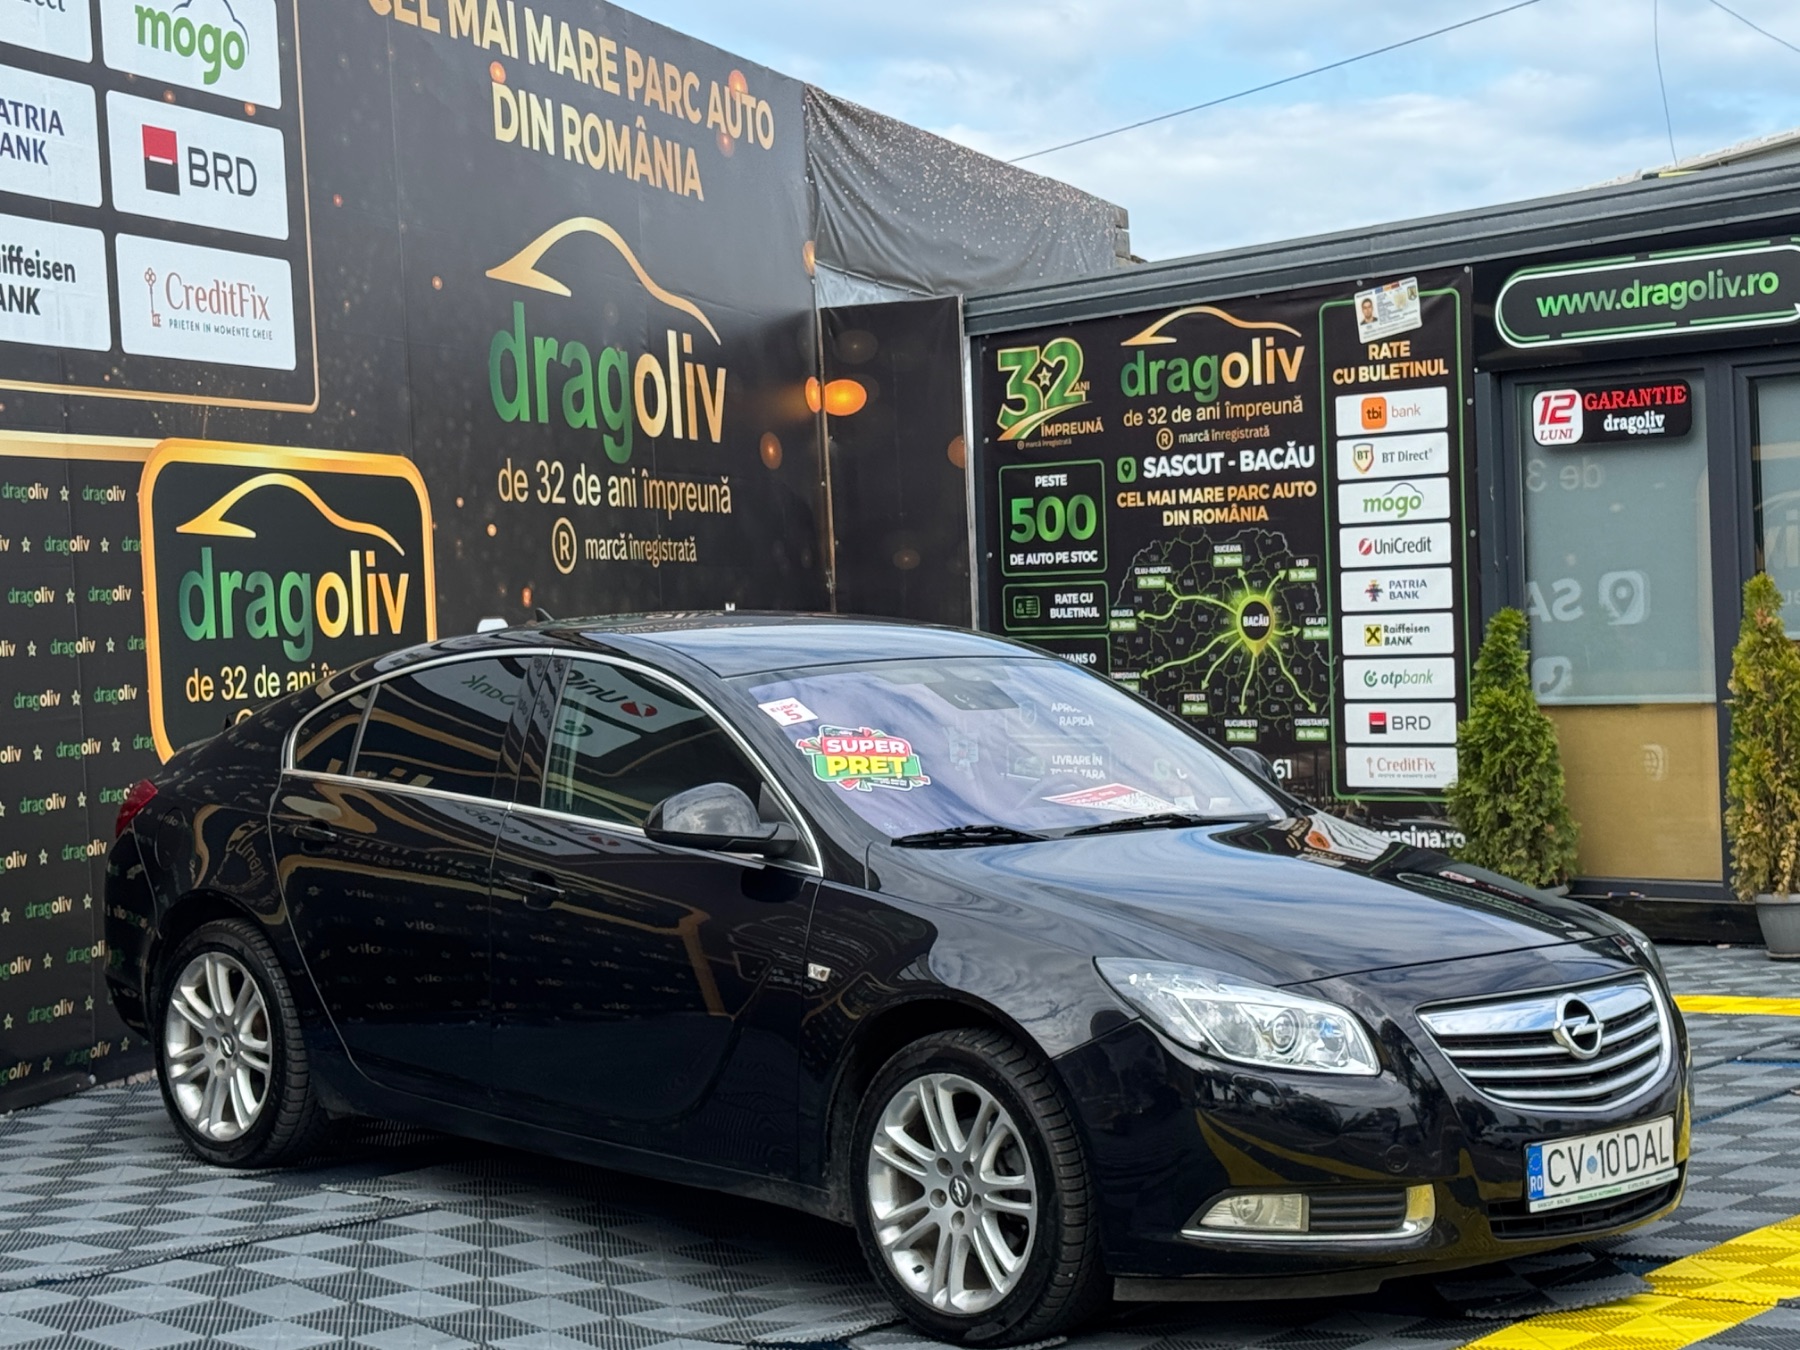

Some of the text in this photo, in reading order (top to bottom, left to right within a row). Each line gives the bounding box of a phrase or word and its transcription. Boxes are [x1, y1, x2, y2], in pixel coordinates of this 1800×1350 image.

[135, 4, 246, 85] mogo
[449, 0, 518, 59] MAI
[524, 7, 620, 95] MARE
[625, 46, 701, 124] PARC
[707, 80, 775, 150] AUTO
[491, 82, 704, 201] DIN ROMÂNIA
[187, 146, 258, 197] BRD
[165, 271, 271, 322] CreditFix
[1536, 268, 1780, 318] www.dragoliv.ro
[168, 318, 273, 341] PRIETEN IN MOMENTE CHEIE
[1368, 340, 1411, 361] RATE
[1120, 336, 1305, 402] dragoliv
[1332, 358, 1449, 385] CU BULETINUL
[489, 301, 727, 464] dragoliv
[997, 337, 1091, 430] 32 ANI
[1584, 384, 1687, 412] GARANTIE
[1123, 395, 1303, 427] de 32 de ani împreună
[1366, 403, 1421, 420] tbi bank
[1539, 394, 1576, 426] 12
[1041, 416, 1105, 437] ÎMPREUNĂ
[1603, 410, 1665, 435] dragoliv
[1178, 429, 1210, 444] marcă
[1211, 425, 1270, 444] înregistrată
[1540, 428, 1574, 441] LUNI
[1143, 451, 1225, 479] SASCUT
[1239, 441, 1316, 473] BACĂU
[1356, 450, 1370, 461] BT
[1382, 451, 1396, 464] BT
[498, 457, 732, 520] de 32 de ani împreună
[1035, 474, 1068, 488] PESTE
[2, 482, 126, 505] dragoliv dragoliv
[1116, 480, 1317, 508] CEL MAI MARE PARC AUTO
[1163, 505, 1269, 527] DIN ROMÂNIA
[1362, 495, 1422, 518] mogo
[1010, 494, 1097, 543] 500
[44, 534, 90, 556] dragoliv
[585, 532, 628, 561] marcă
[629, 532, 698, 568] înregistrată
[1374, 536, 1432, 555] UniCredit
[1010, 550, 1098, 566] DE AUTO PE STOC
[8, 584, 132, 607] dragoliv dragoliv
[1388, 579, 1428, 590] PATRIA
[1388, 589, 1419, 600] BANK
[179, 546, 409, 662] dragoliv
[1055, 592, 1094, 605] RATE CU
[1050, 606, 1100, 619] BULETINUL
[1242, 614, 1270, 628] BACĂU
[1383, 623, 1430, 635] Raiffeisen
[50, 636, 96, 658] dragoliv
[1384, 636, 1413, 647] BANK
[186, 667, 214, 703] de
[220, 665, 248, 701] 32
[254, 664, 280, 699] de
[1380, 669, 1433, 687] otpbank
[13, 684, 137, 711] dragoliv dragoliv
[769, 703, 799, 713] EURO
[784, 709, 802, 721] 5
[1391, 715, 1432, 731] BRD
[56, 738, 102, 760] dragoliv
[826, 738, 905, 754] SUPER
[1377, 757, 1436, 772] CreditFix
[20, 793, 66, 815] dragoliv
[62, 839, 107, 862] dragoliv
[25, 896, 72, 920] dragoliv
[66, 940, 105, 964] dragoli
[28, 999, 74, 1024] dragoliv
[65, 1041, 110, 1067] dragoliv
[1547, 1143, 1585, 1188] CV
[1530, 1175, 1543, 1193] RO
